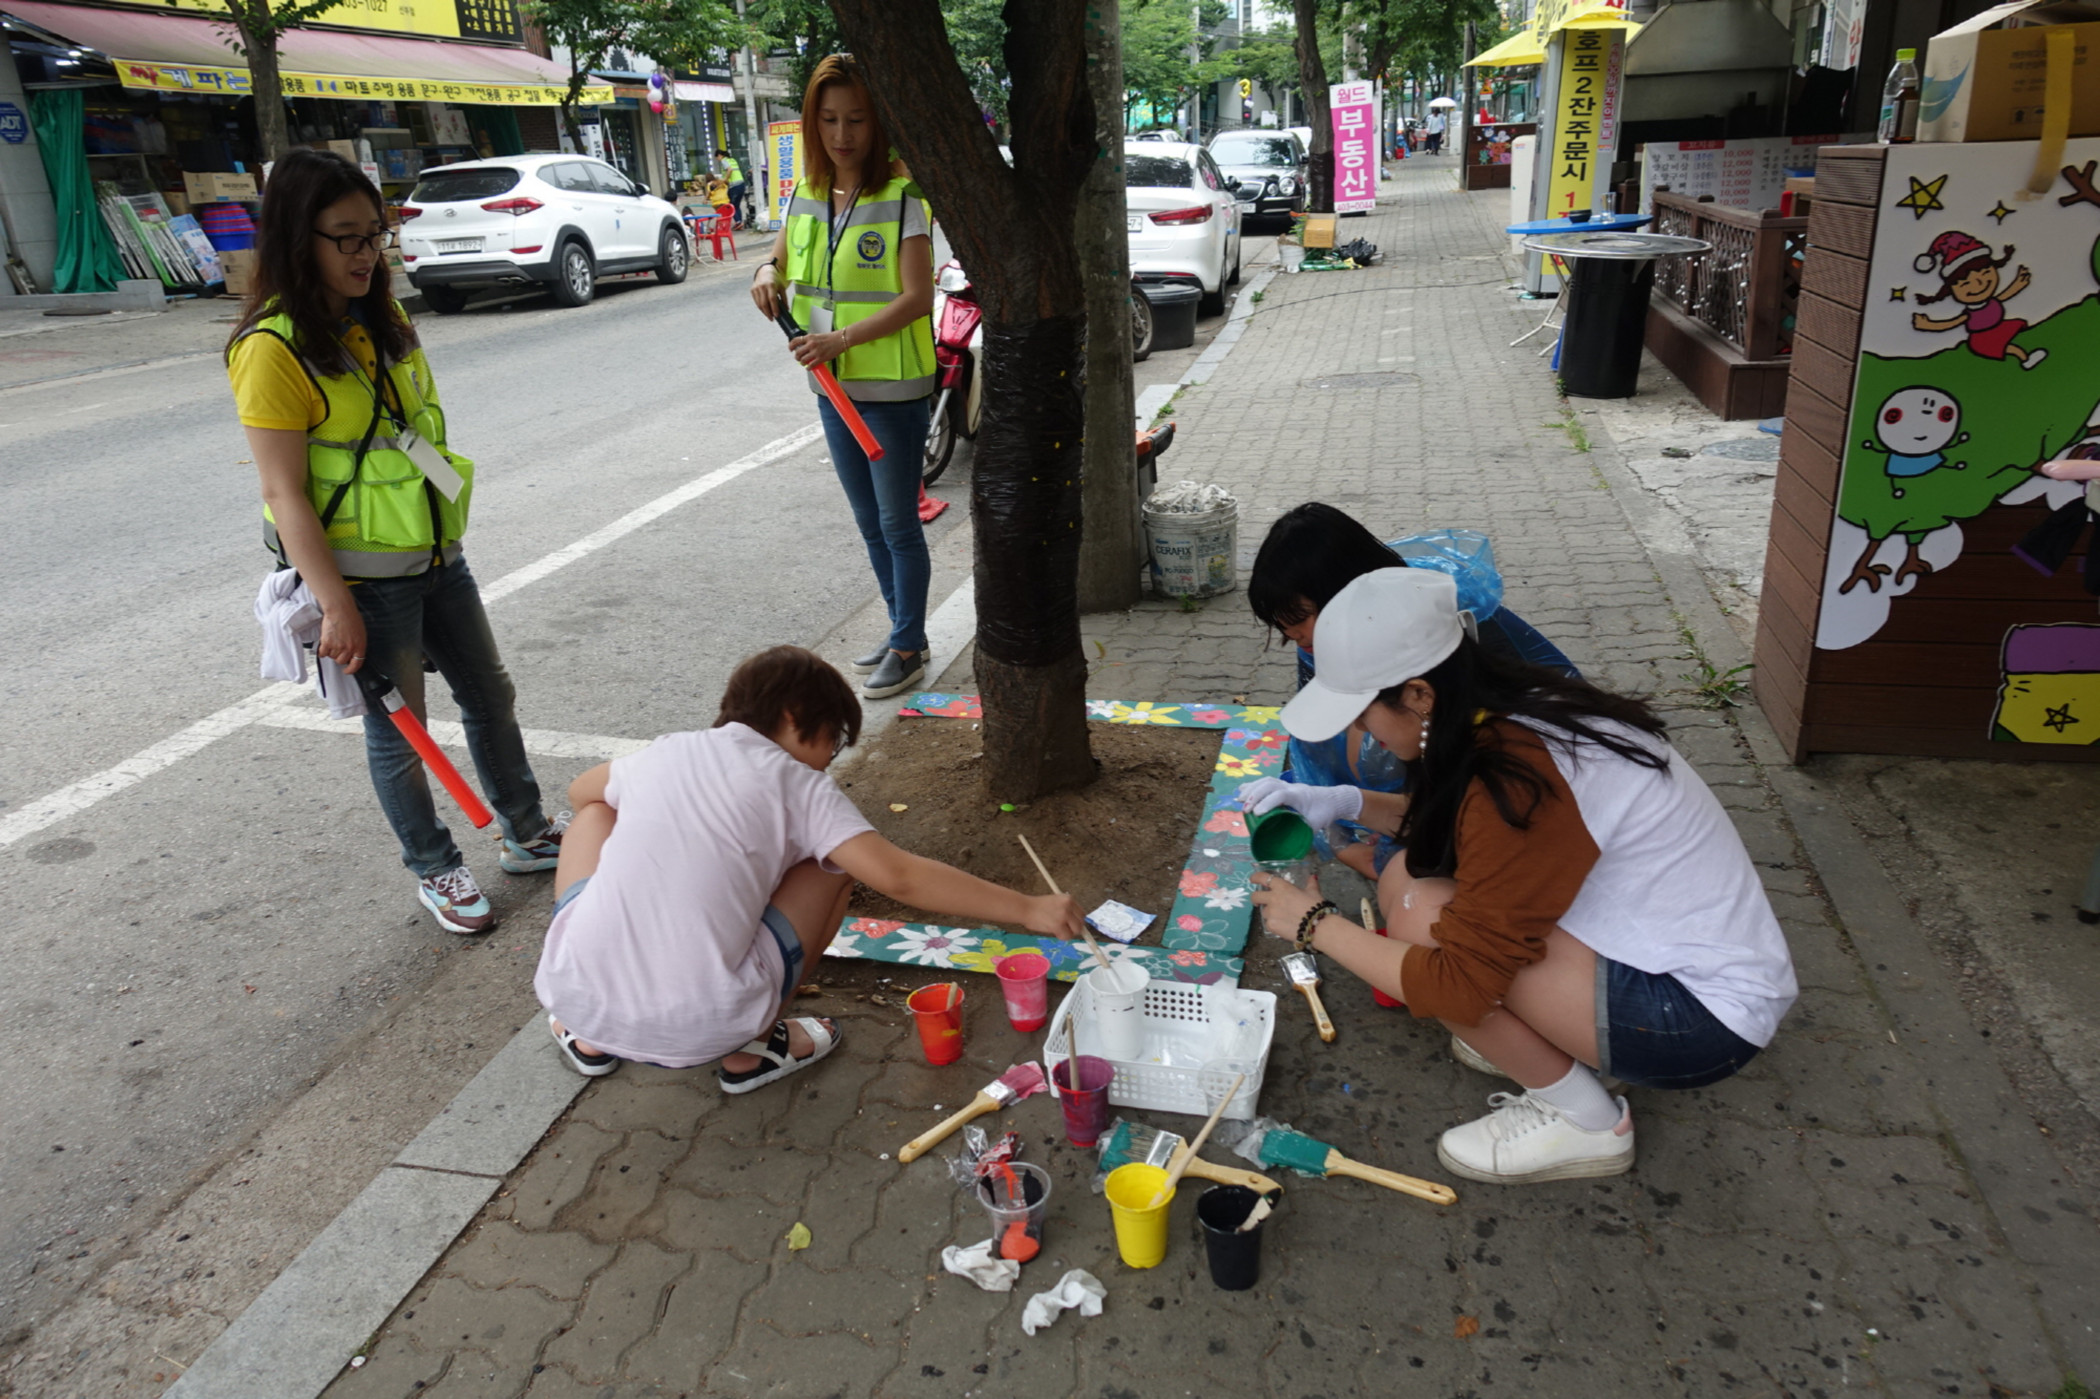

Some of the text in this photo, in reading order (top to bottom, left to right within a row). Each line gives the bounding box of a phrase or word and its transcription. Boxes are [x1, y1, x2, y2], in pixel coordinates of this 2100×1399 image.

[1337, 86, 1366, 104] 월드
[1, 115, 21, 129] ADT
[778, 134, 794, 179] 생활용품
[1338, 109, 1368, 197] 부동산
[1722, 159, 1753, 170] 12,000
[1721, 169, 1752, 179] 12,000
[1720, 180, 1751, 190] 12,000
[1155, 545, 1191, 556] CERAFIX
